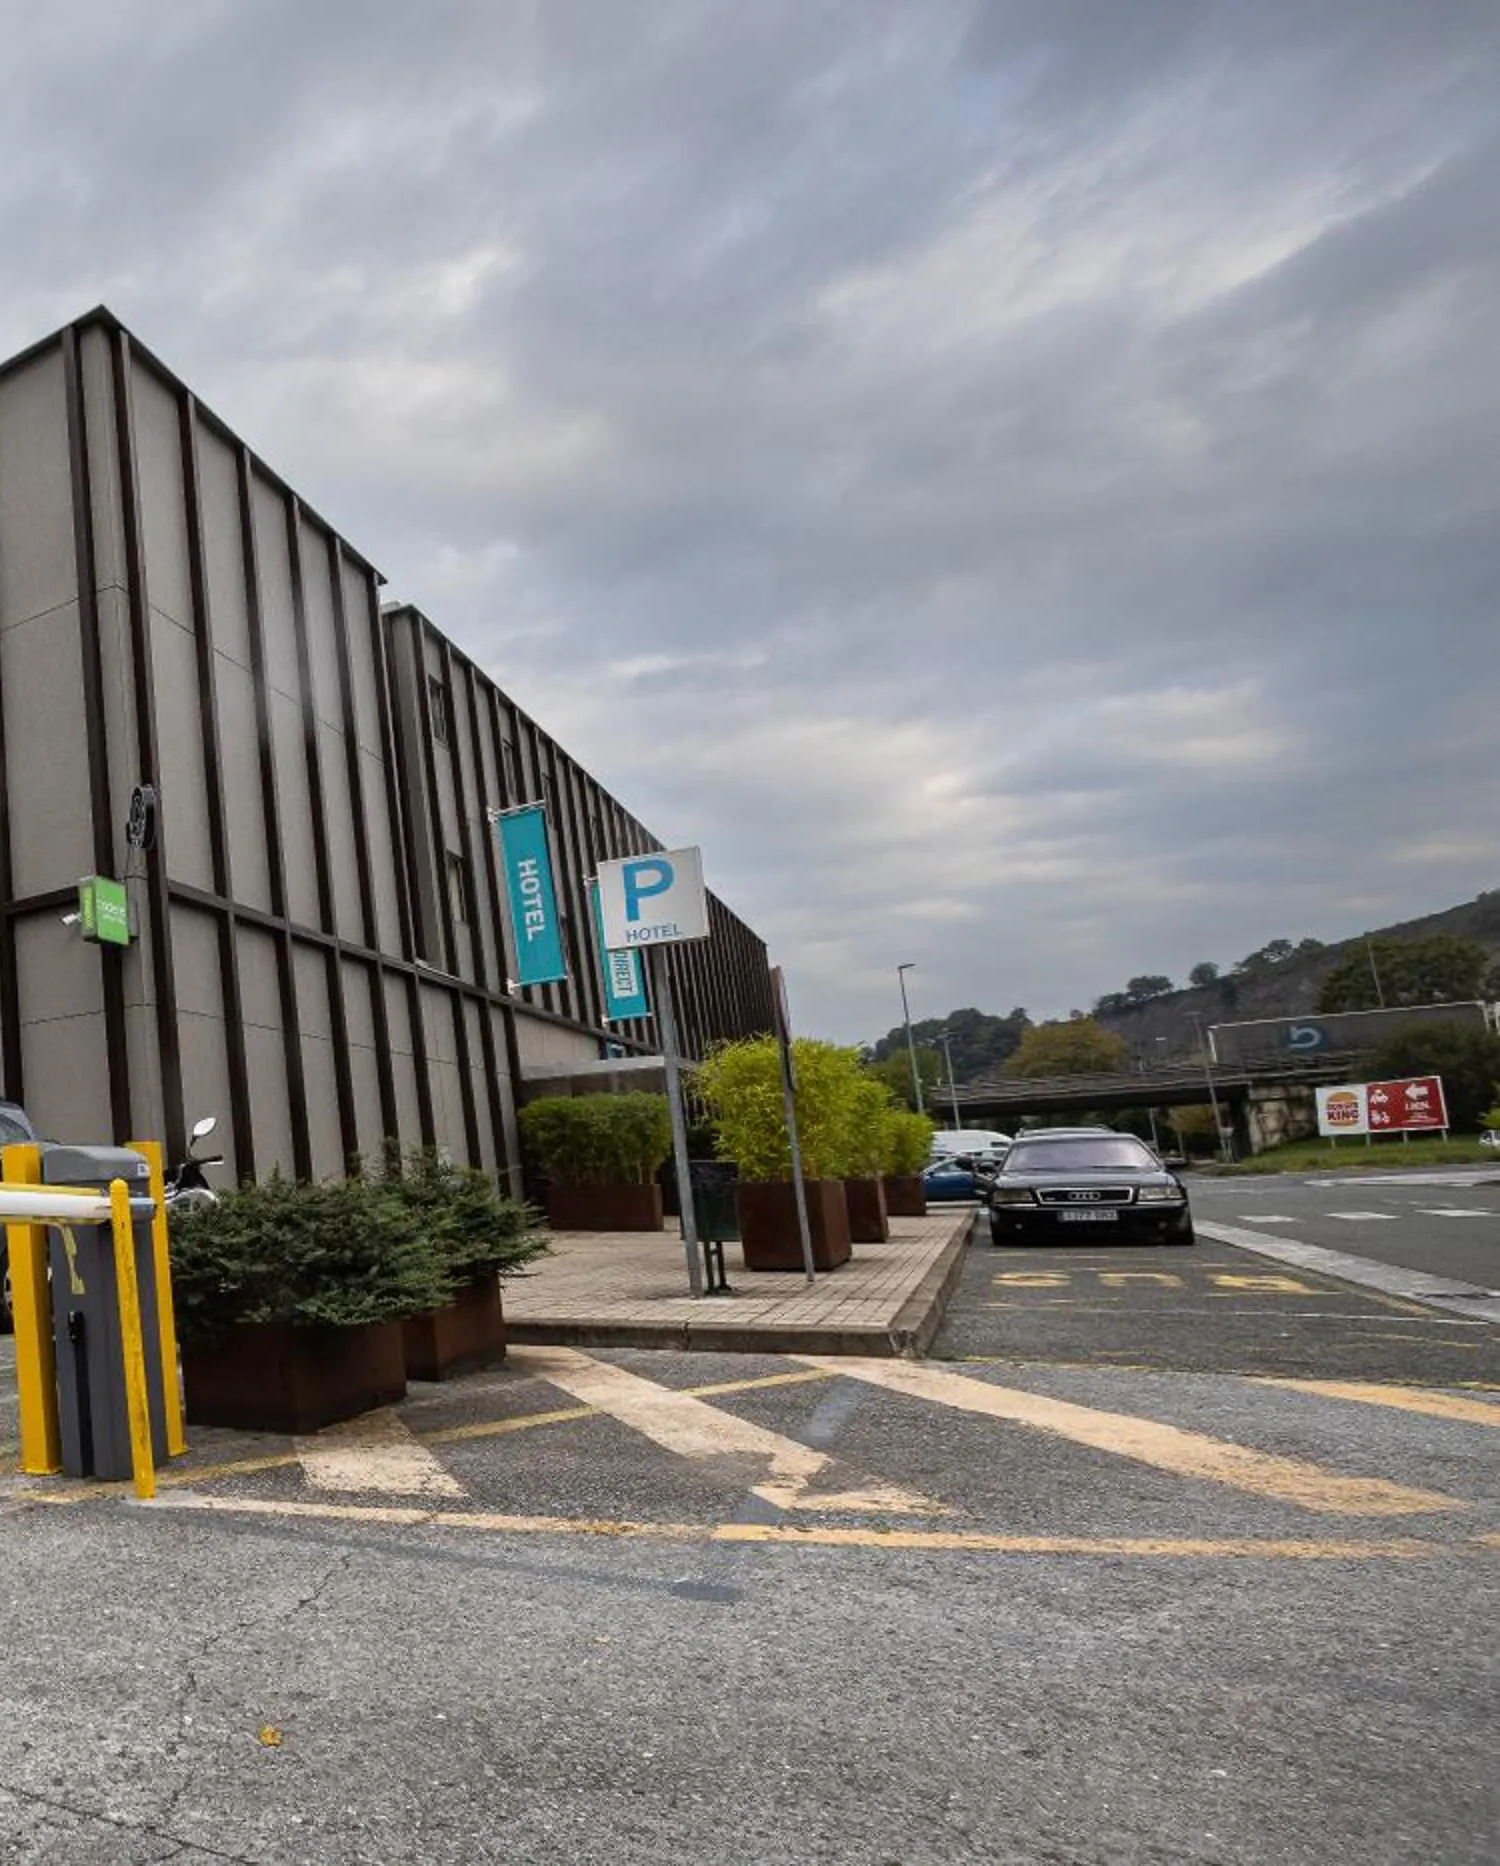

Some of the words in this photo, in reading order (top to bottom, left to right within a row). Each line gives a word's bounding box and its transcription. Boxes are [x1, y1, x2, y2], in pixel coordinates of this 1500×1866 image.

[517, 859, 545, 942] HOTEL
[622, 858, 674, 922] P
[626, 923, 683, 943] HOTEL
